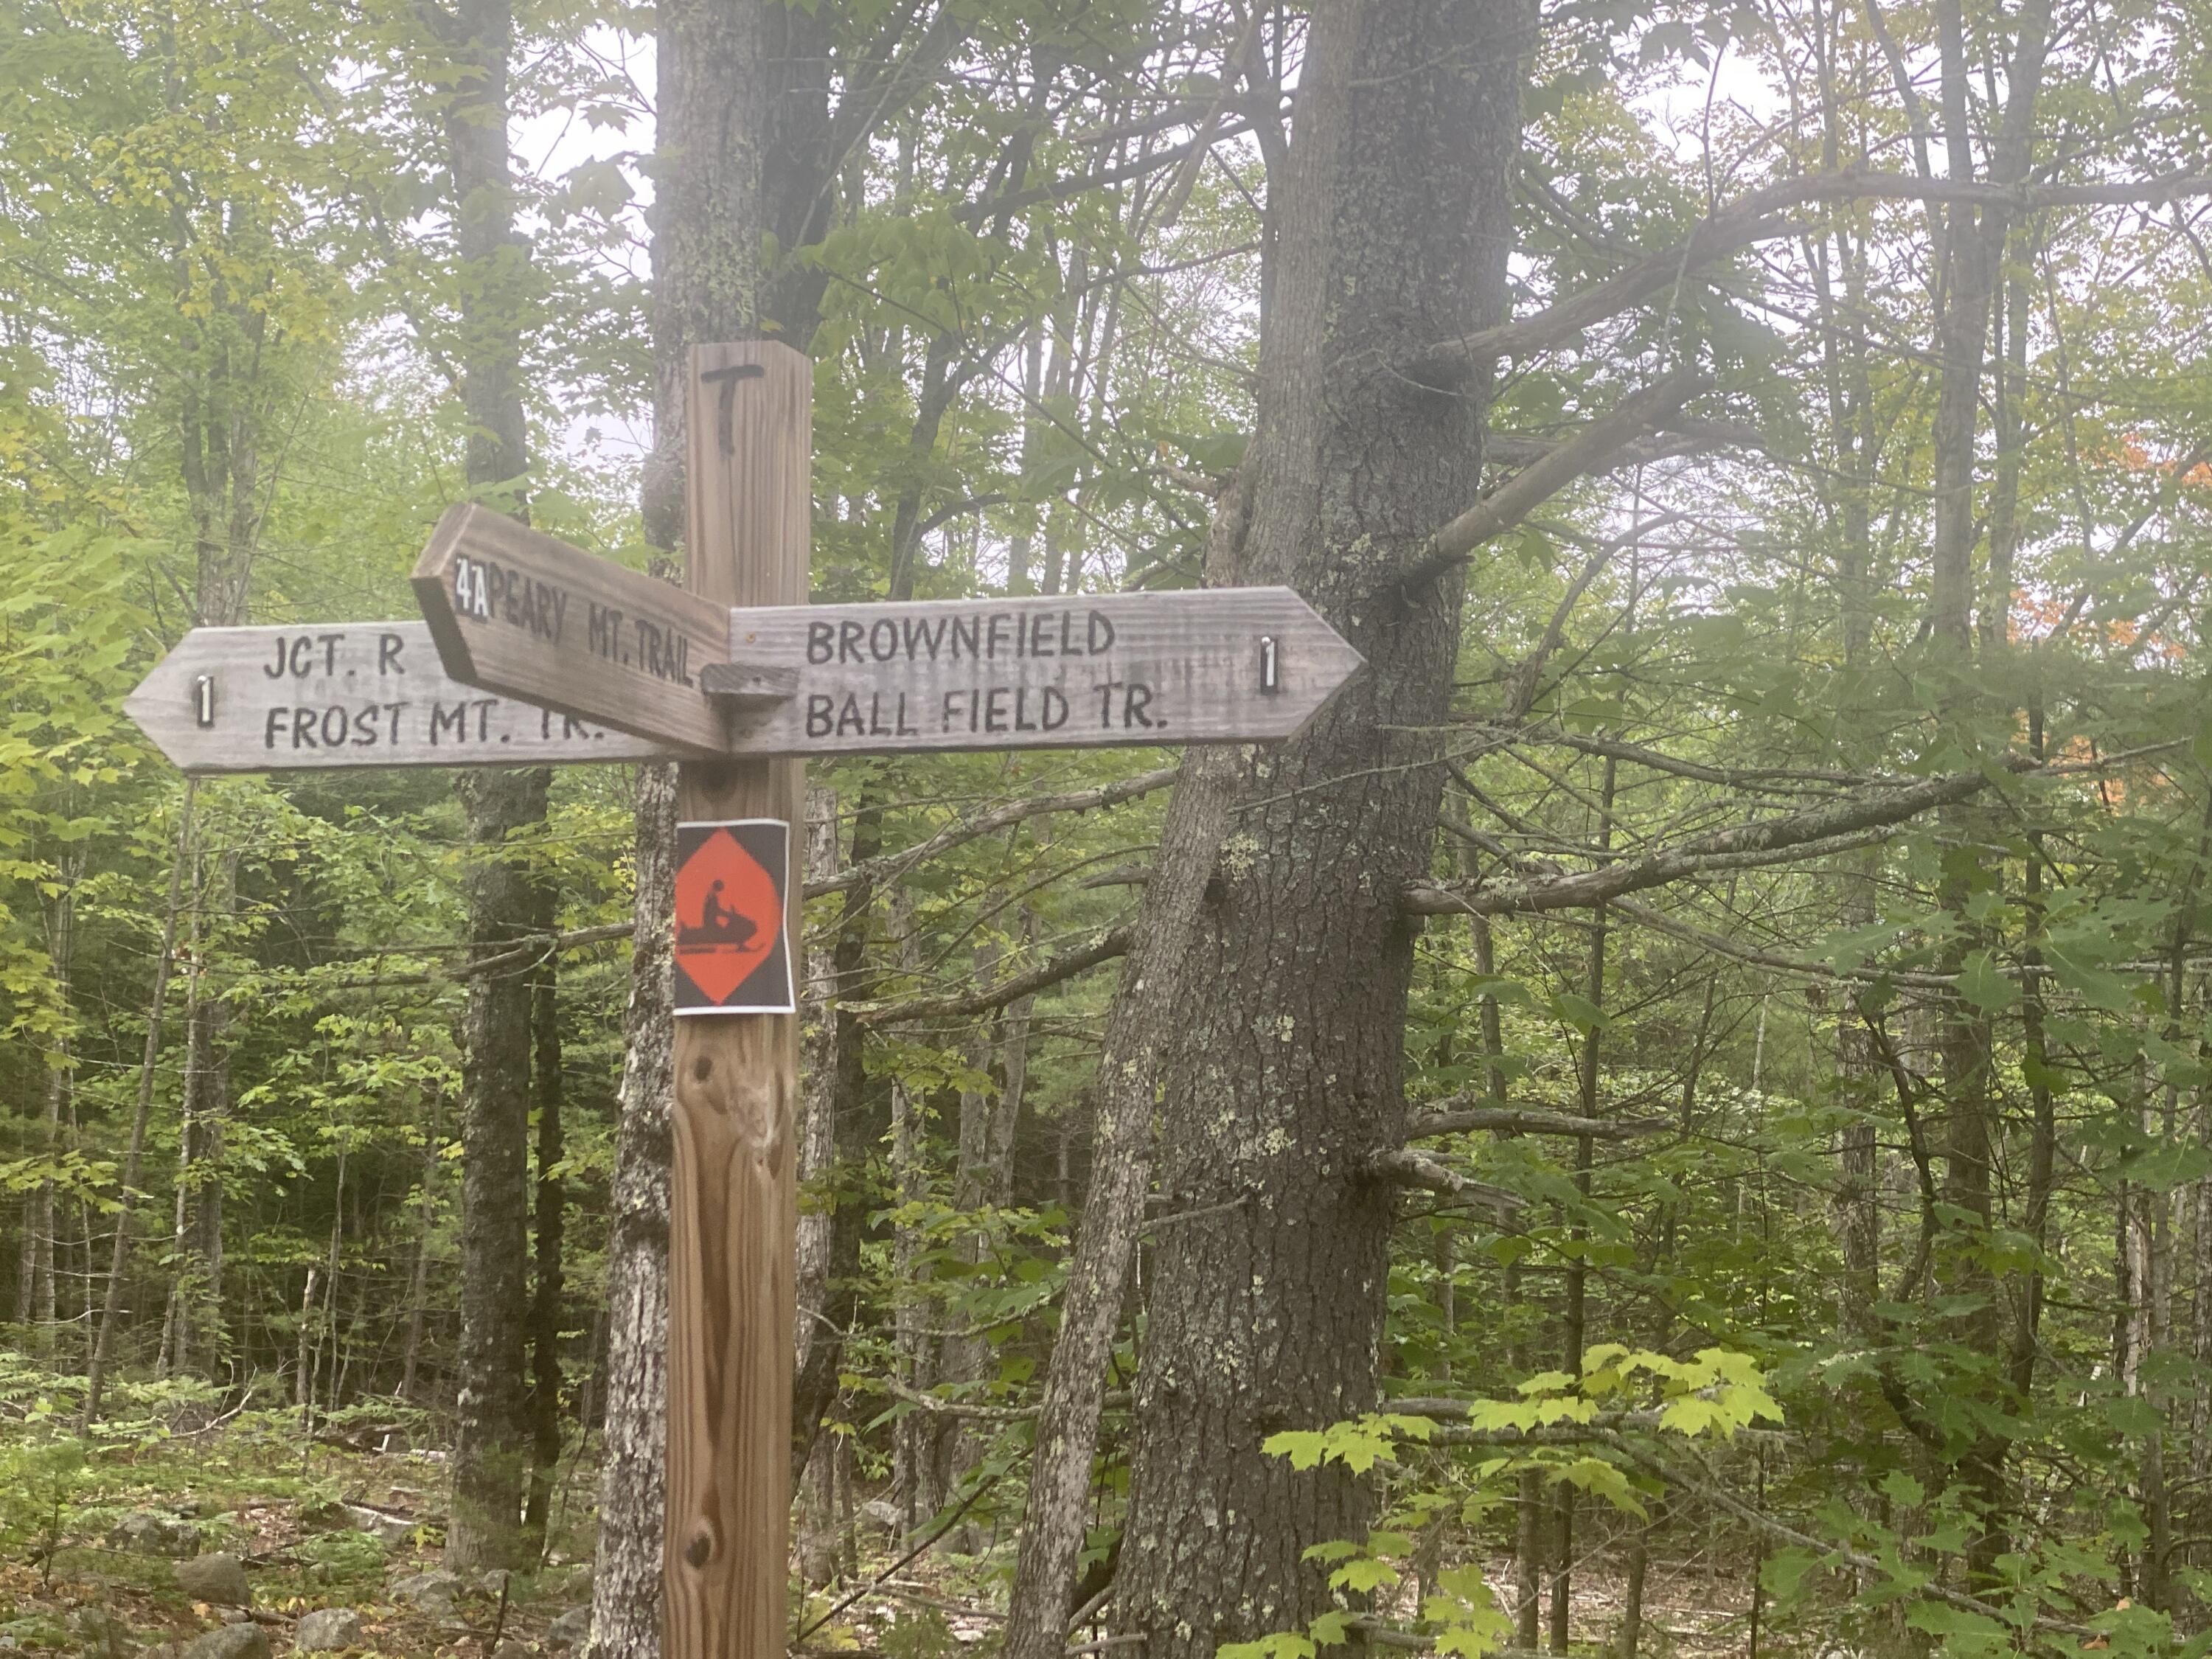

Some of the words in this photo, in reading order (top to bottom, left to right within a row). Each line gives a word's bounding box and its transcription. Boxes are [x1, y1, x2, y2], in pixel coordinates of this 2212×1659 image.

[489, 561, 566, 644] PEARY
[589, 602, 630, 666] MT.
[634, 619, 693, 688] TRAIL
[807, 609, 1116, 665] BROWNFIELD
[263, 633, 356, 679] JCT.
[265, 701, 410, 748] FROST
[428, 698, 510, 745] MT.
[805, 691, 917, 737] BALL
[942, 686, 1069, 734] FIELD
[1093, 680, 1169, 729] TR.
